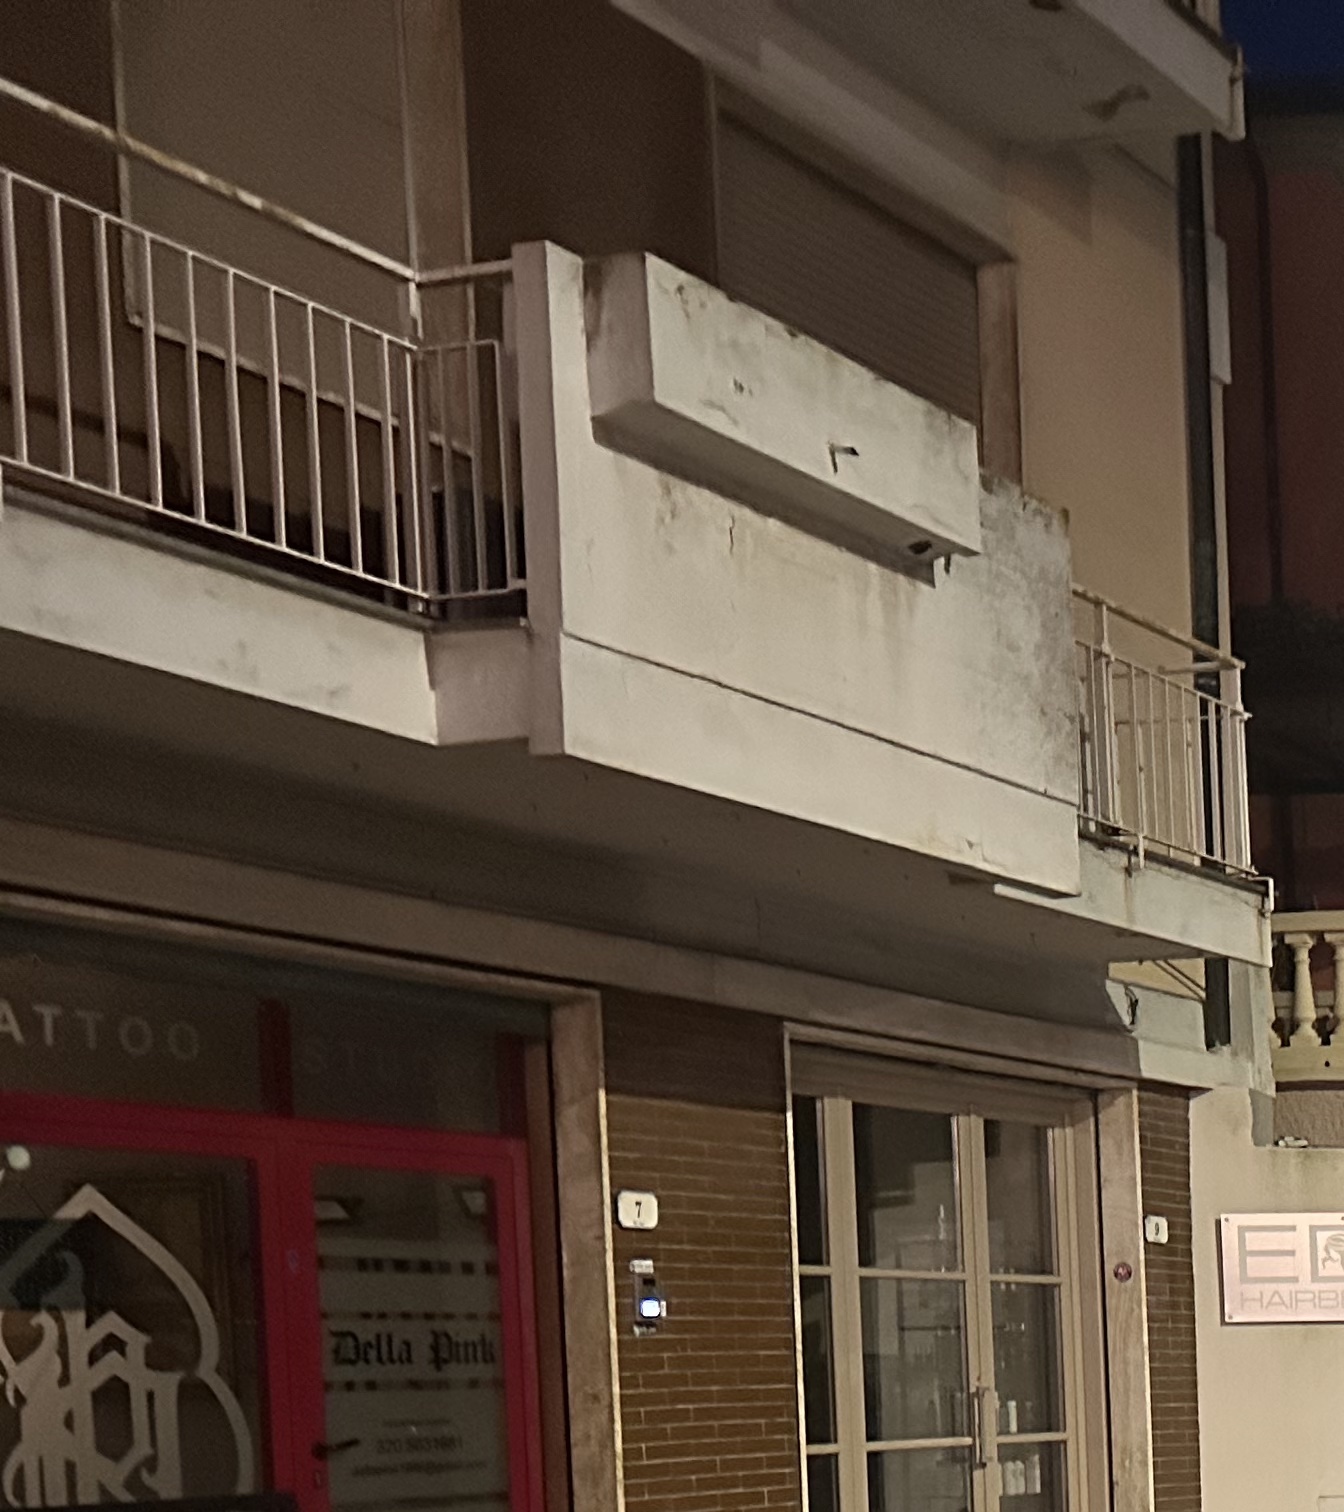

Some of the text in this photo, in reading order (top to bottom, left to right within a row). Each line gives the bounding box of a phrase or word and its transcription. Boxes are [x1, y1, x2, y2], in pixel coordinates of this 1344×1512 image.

[634, 1201, 642, 1219] 7
[329, 1329, 496, 1372] Della Pink
